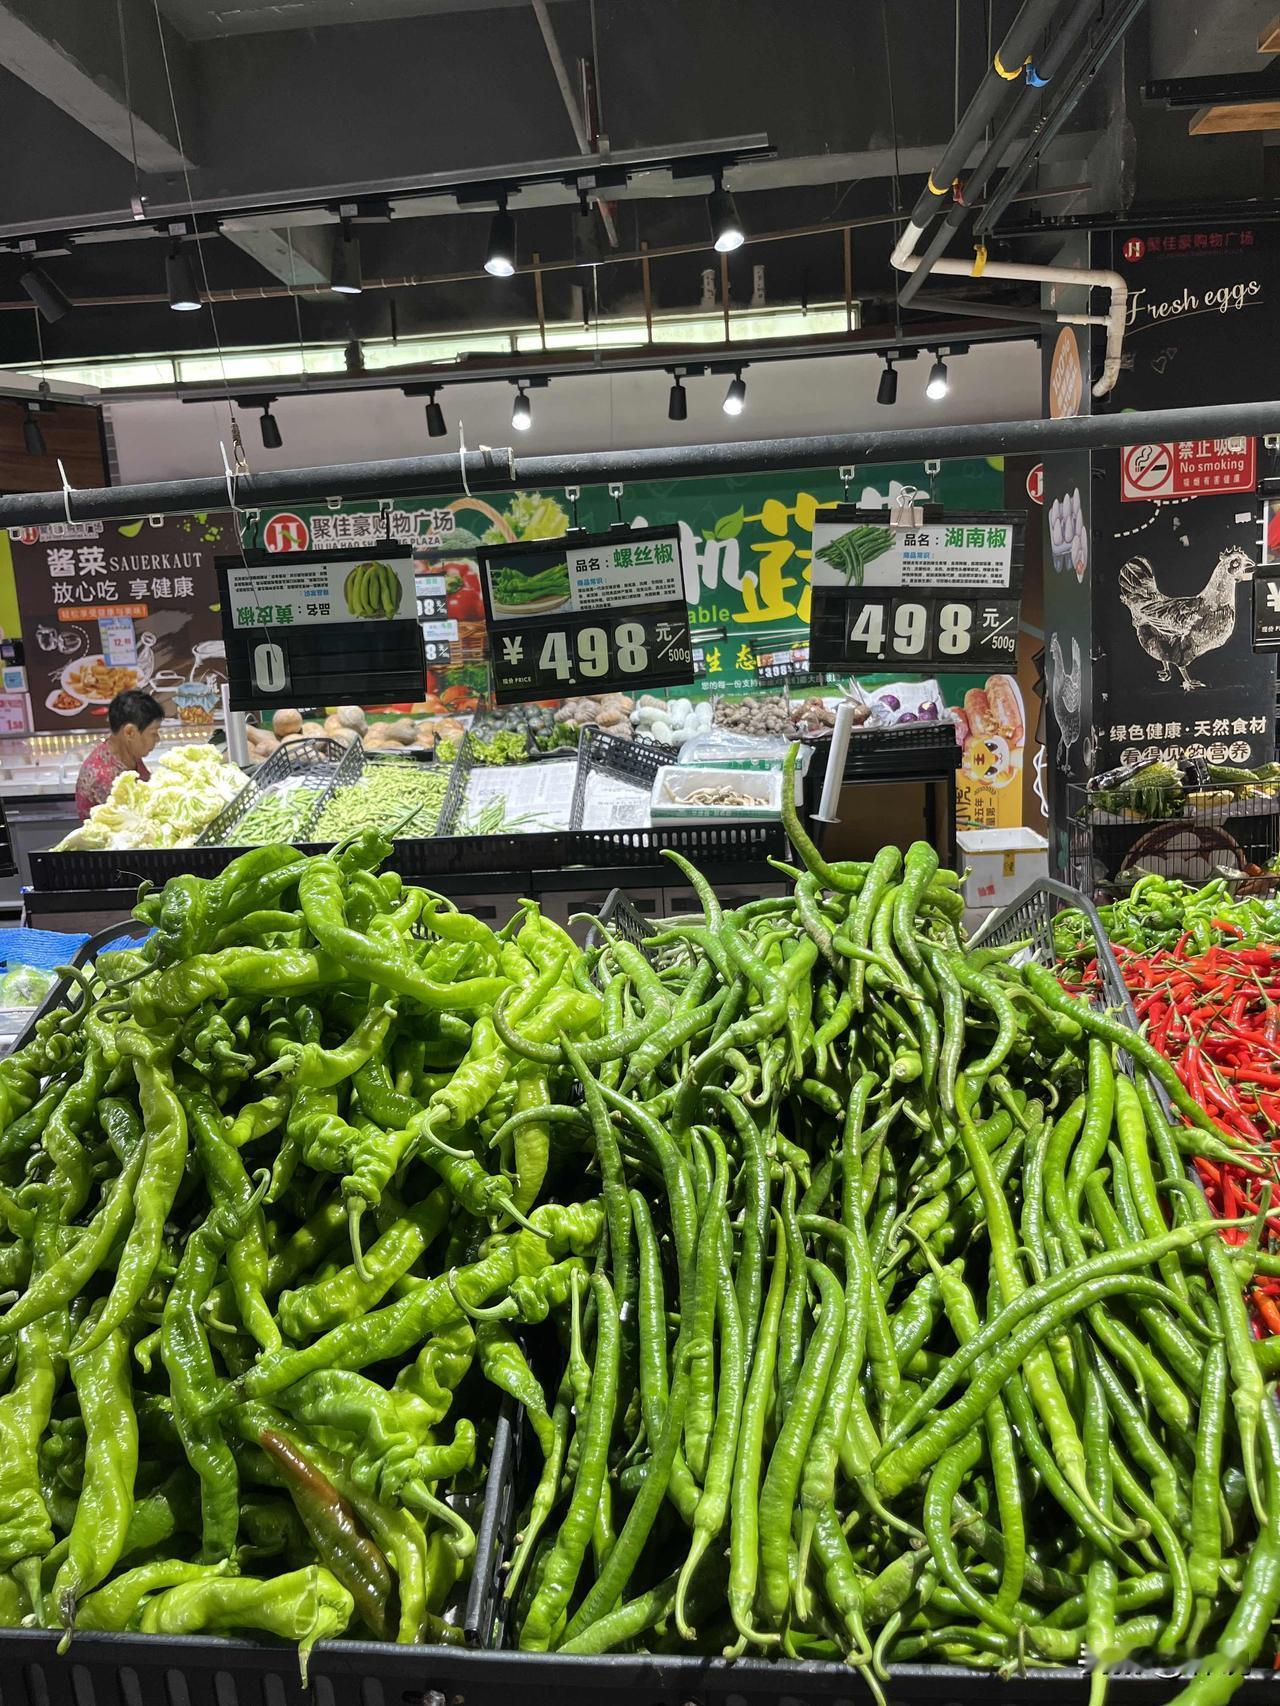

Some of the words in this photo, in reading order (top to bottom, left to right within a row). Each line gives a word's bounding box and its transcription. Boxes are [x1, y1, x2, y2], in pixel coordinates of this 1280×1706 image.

[1126, 288, 1199, 326] Fresh
[1204, 280, 1261, 314] eggs
[1180, 461, 1195, 474] No
[1198, 459, 1244, 472] smoking
[312, 510, 454, 540] 聚佳豪购物广场
[411, 536, 440, 546] PLAZA
[46, 546, 107, 577] 酱菜
[110, 552, 202, 571] SAUERKAUT
[52, 579, 119, 604] 放心吃
[129, 576, 194, 600] 享健康
[689, 605, 730, 624] able
[850, 603, 973, 660] 4.98
[538, 622, 648, 685] 4.98
[1121, 741, 1250, 766] 看得见的营养
